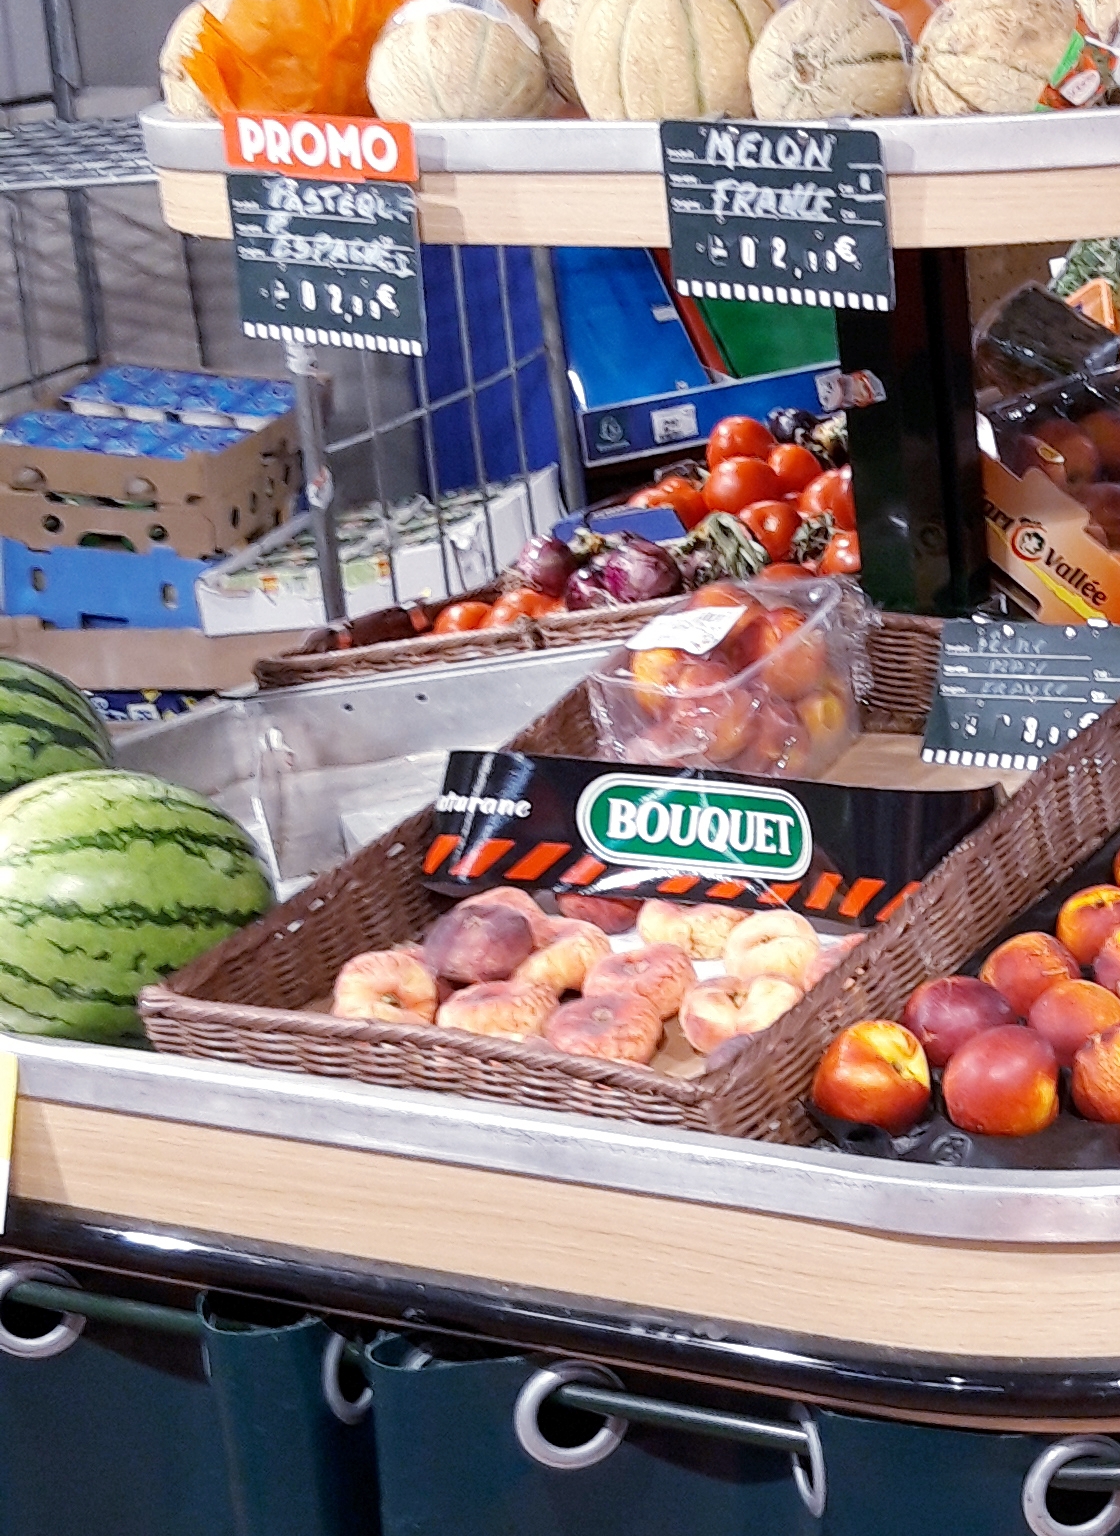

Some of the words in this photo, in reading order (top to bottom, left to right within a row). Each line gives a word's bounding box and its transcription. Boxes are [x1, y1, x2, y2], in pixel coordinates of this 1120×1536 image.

[236, 117, 398, 172] PROMO
[705, 128, 834, 171] MELON
[711, 178, 835, 221] FRANCE
[1045, 547, 1107, 606] Vallée
[606, 797, 795, 856] BOUQUET
